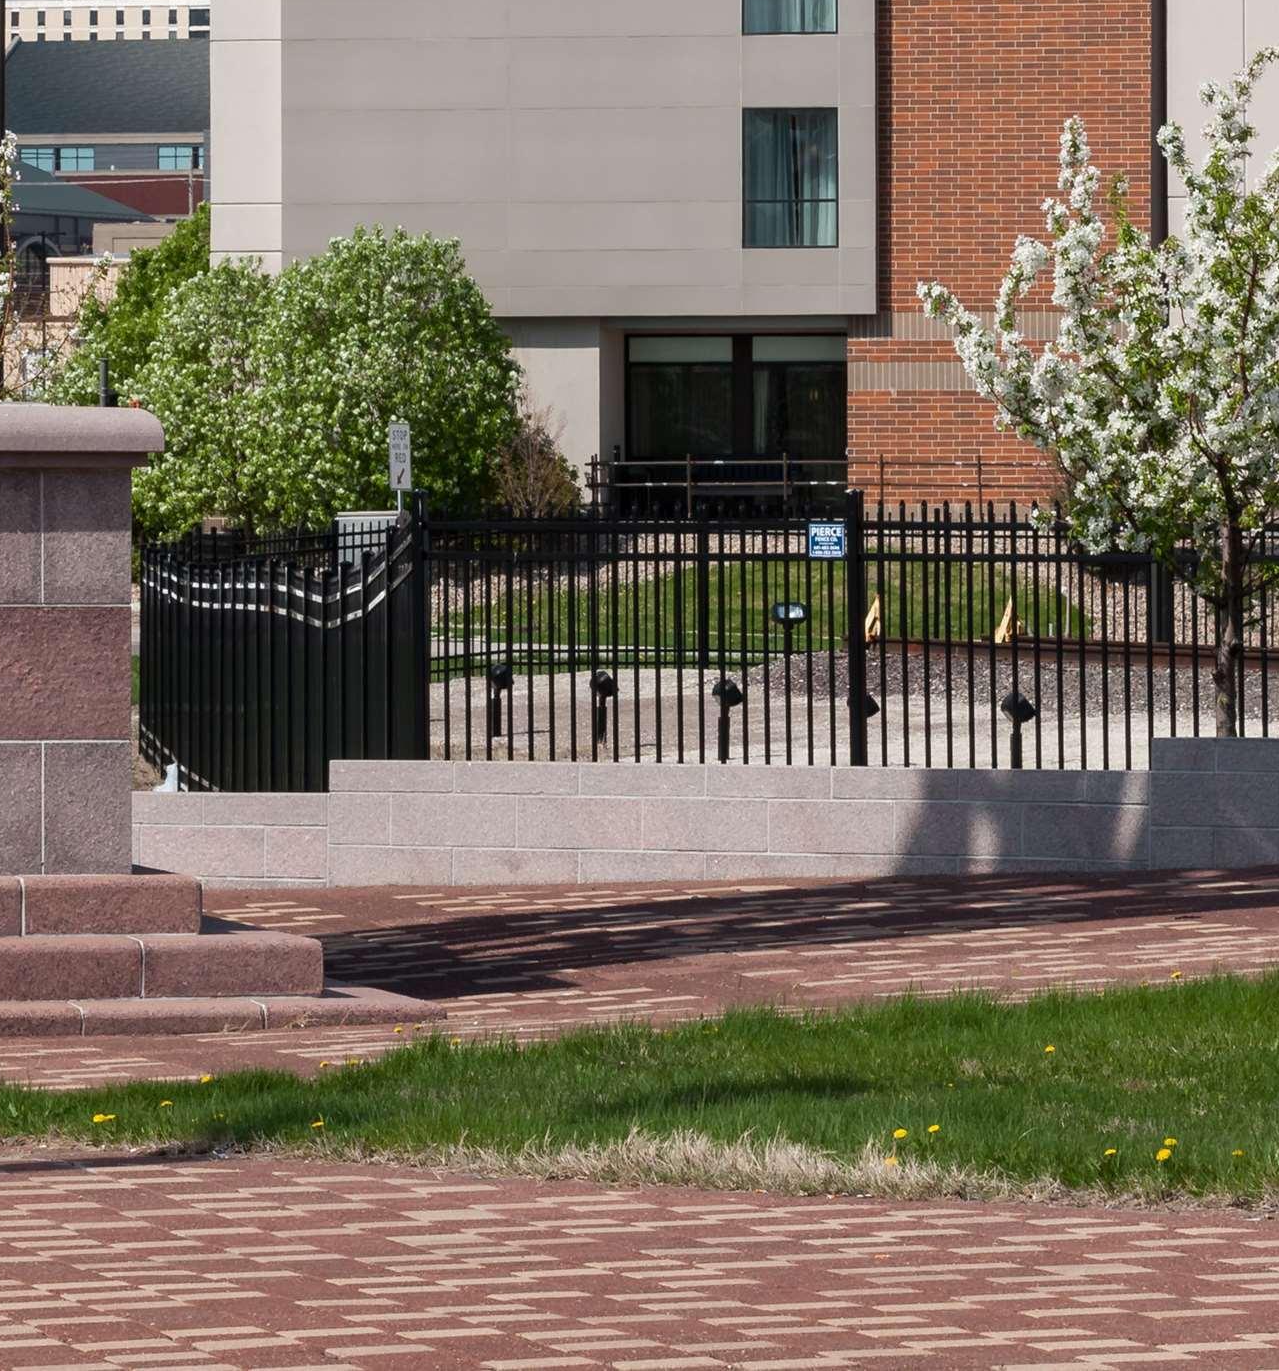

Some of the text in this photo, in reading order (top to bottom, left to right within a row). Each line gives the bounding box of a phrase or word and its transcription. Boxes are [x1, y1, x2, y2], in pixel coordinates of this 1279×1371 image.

[392, 430, 407, 440] STOP
[395, 453, 406, 463] RED
[811, 527, 842, 536] PIERCE
